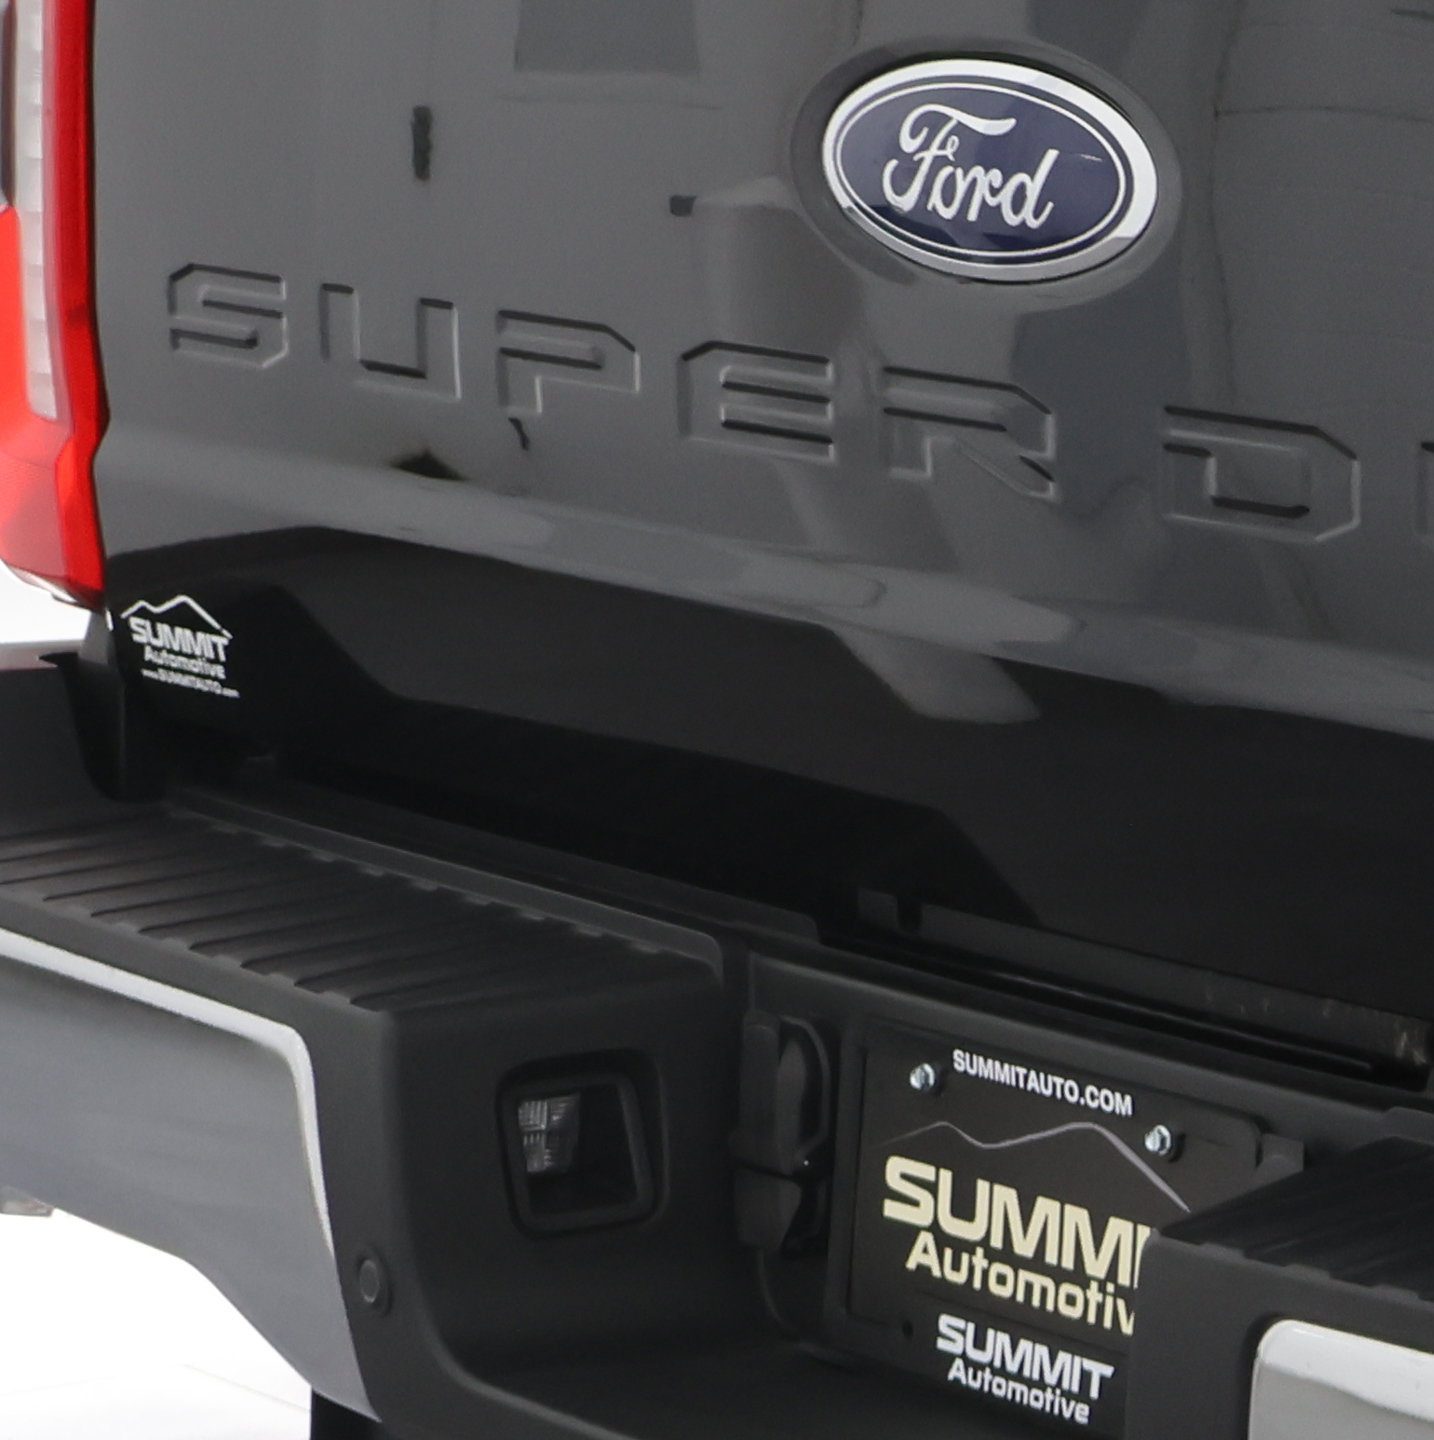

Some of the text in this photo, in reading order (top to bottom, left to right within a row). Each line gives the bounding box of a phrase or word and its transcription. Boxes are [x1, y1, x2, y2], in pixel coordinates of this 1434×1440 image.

[881, 103, 1061, 230] Ford
[168, 262, 1060, 502] SUPER
[128, 615, 231, 663] SUMMIT
[952, 1048, 1134, 1117] SUMMITAUTO.COM
[935, 1312, 1116, 1401] SUMMIT
[946, 1356, 1092, 1426] Automotive
